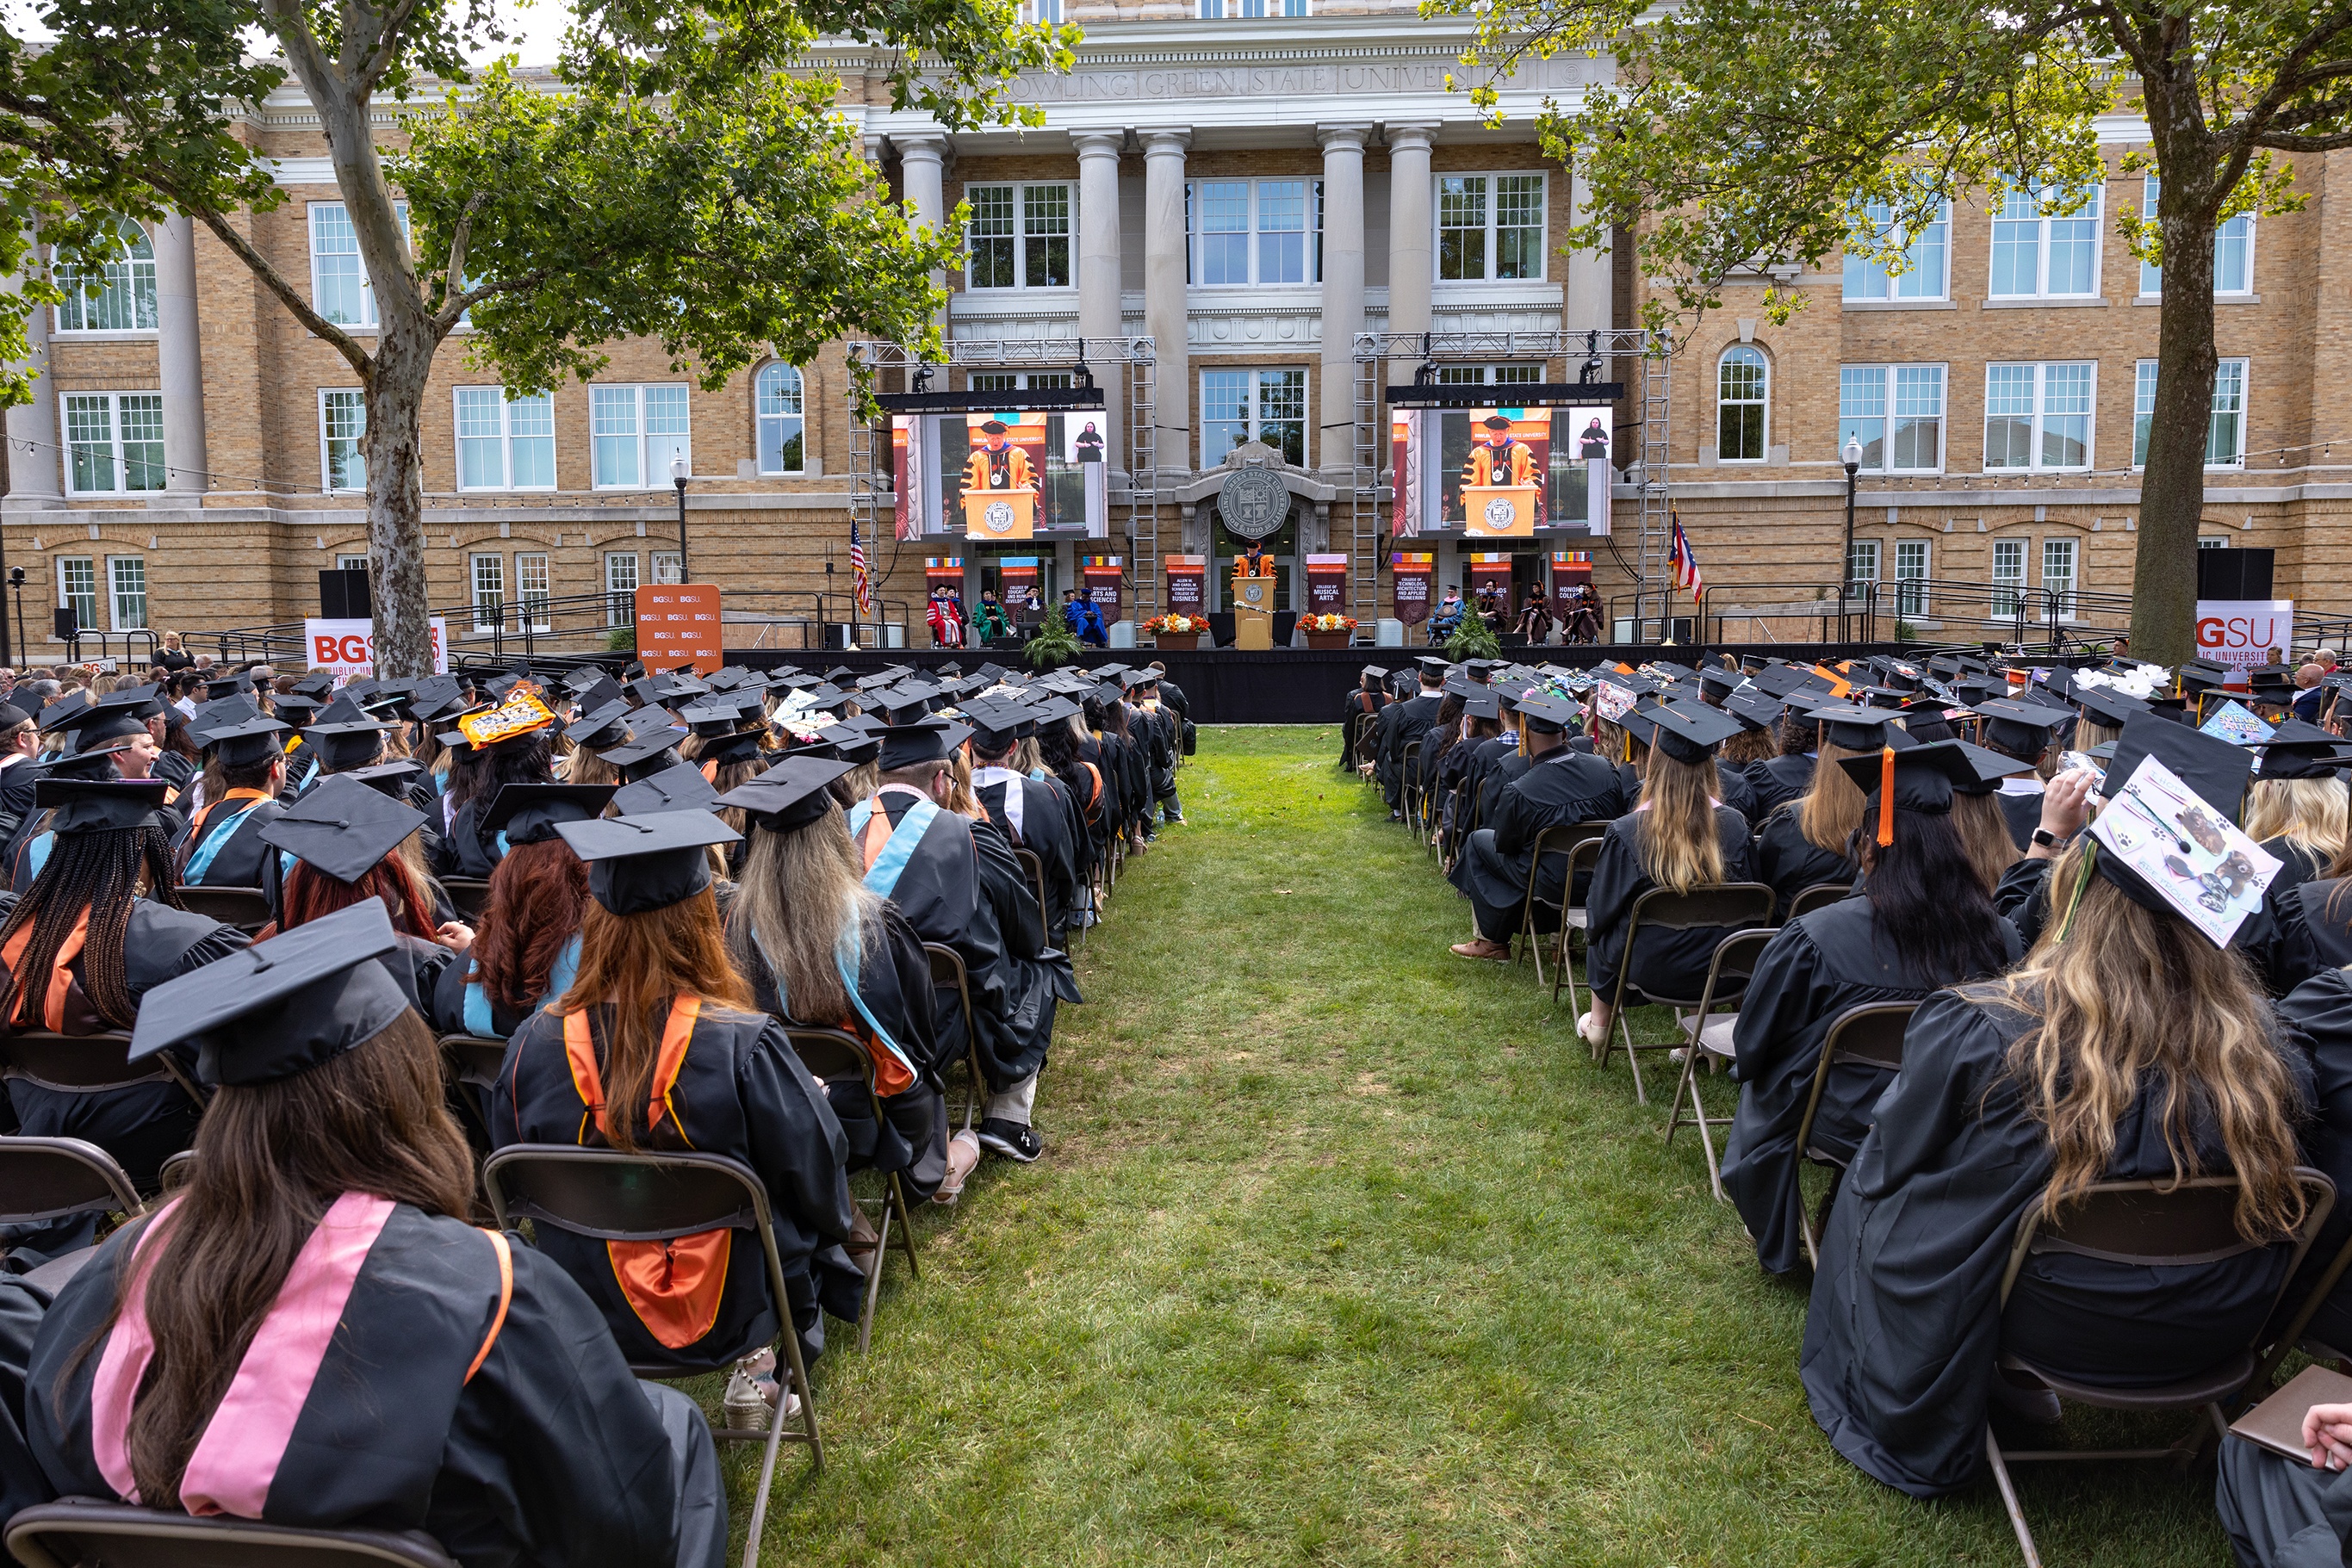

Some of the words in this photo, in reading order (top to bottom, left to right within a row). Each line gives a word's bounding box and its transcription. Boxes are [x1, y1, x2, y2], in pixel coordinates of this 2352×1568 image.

[1145, 71, 1235, 95] GREEN
[1252, 70, 1326, 91] STATE
[1226, 473, 1247, 493] GREEN
[1249, 472, 1273, 482] STATE
[1224, 495, 1239, 528] BOWLING
[1272, 480, 1285, 524] UNIVERSITY
[2197, 617, 2274, 648] GSU
[314, 635, 373, 664] BG
[431, 627, 441, 676] BGS
[2215, 651, 2268, 661] UNIVERSIT
[83, 663, 114, 673] BGSU
[2225, 714, 2261, 725] YEARS
[2225, 722, 2263, 733] LATER!
[2159, 777, 2187, 795] HOPE
[2138, 860, 2158, 878] ARE
[2160, 878, 2192, 907] PROUD
[2193, 908, 2207, 920] OF
[2209, 920, 2224, 936] ME
